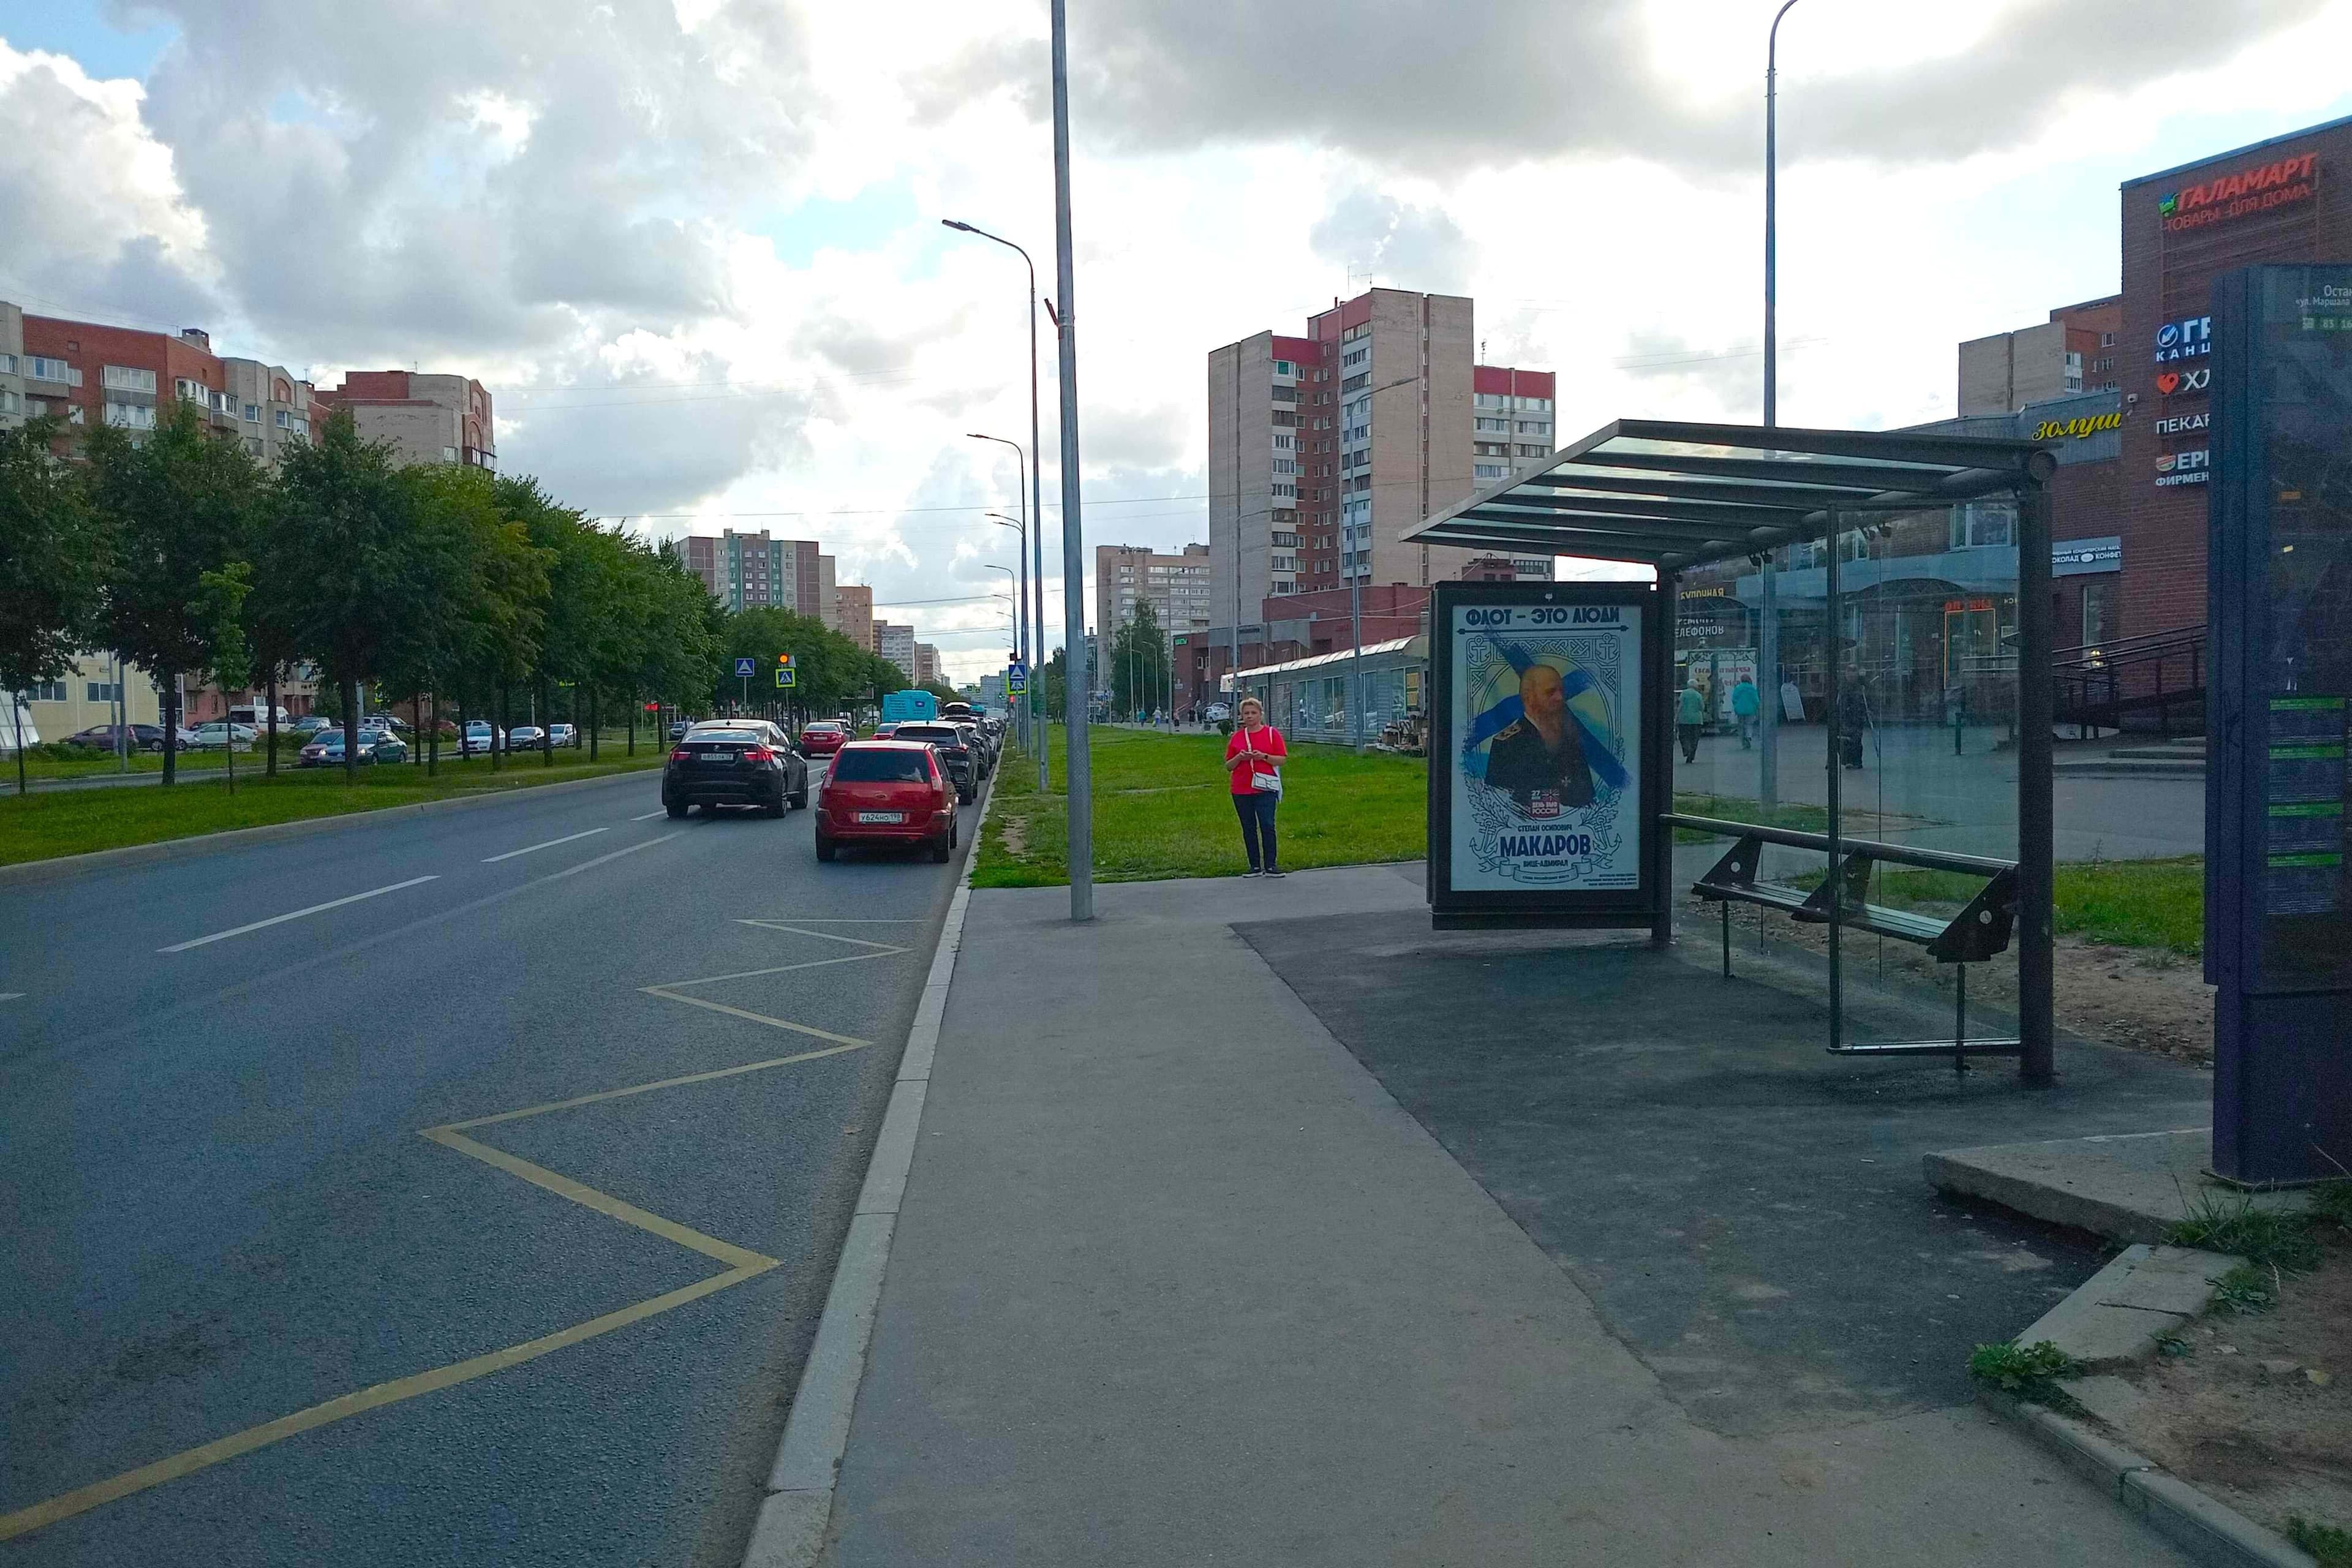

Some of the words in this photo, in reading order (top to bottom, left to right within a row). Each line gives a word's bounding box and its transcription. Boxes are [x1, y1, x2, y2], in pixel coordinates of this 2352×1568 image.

[2179, 153, 2316, 209] ГАЛАМАРТ
[2166, 208, 2221, 232] ТОВАРЫ
[2230, 196, 2259, 217] ДЛЯ
[2263, 183, 2310, 209] ДОМА
[2313, 296, 2351, 307] Маршала
[1466, 608, 1512, 626] ФЛОТ
[1531, 607, 1568, 624] ЭТО
[1572, 607, 1619, 624] ЛЮДИ
[1500, 834, 1591, 857] МАКАРОВ
